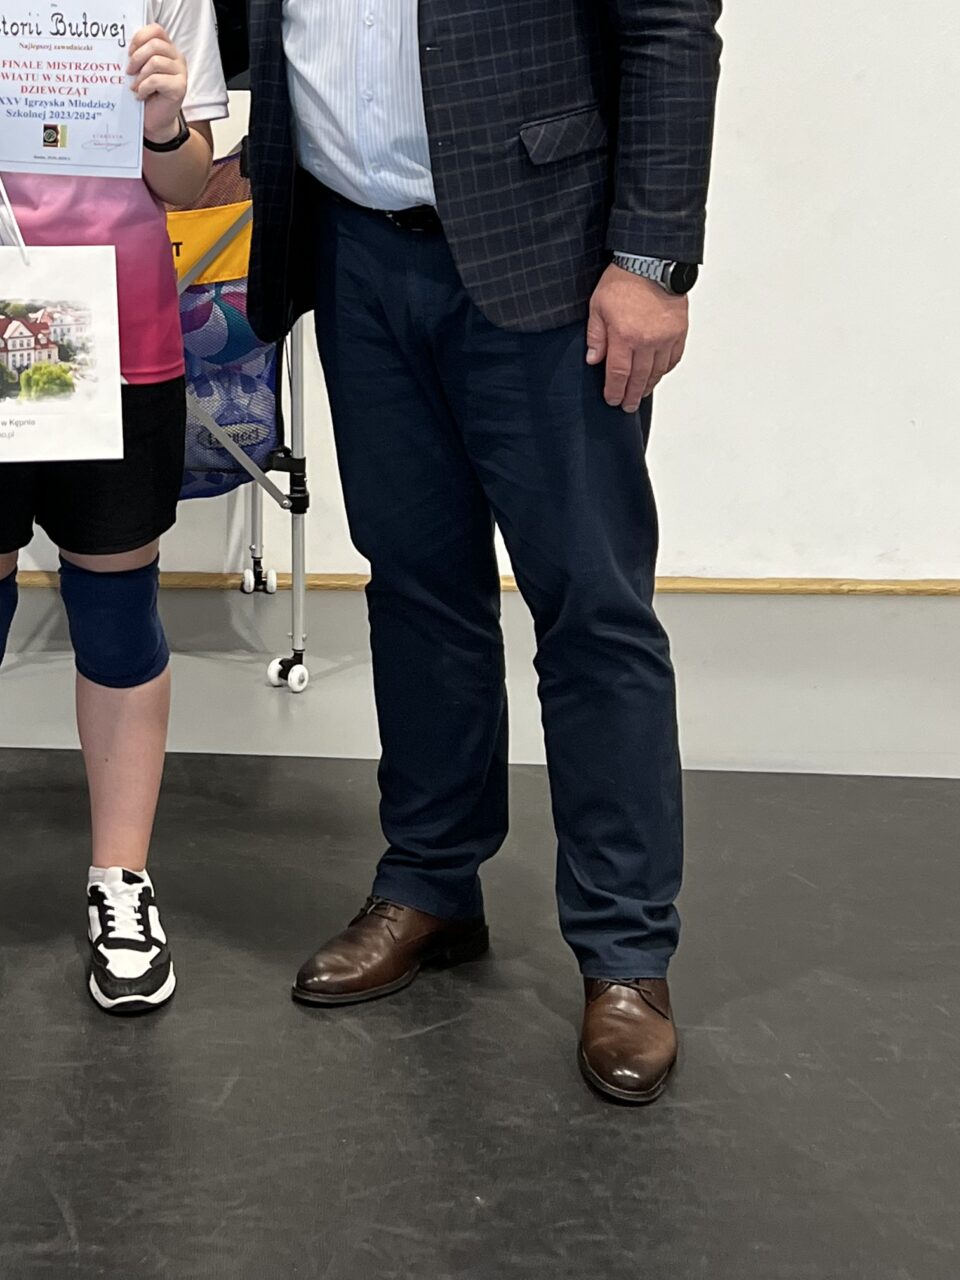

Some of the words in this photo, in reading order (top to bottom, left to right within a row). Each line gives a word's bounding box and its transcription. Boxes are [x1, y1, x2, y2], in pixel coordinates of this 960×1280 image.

[2, 59, 42, 69] FINALE
[46, 60, 122, 71] MISTRZOSTW
[42, 73, 53, 82] W
[56, 73, 125, 85] SIATKÓWCE
[20, 86, 89, 97] DZIEWCZĄT
[25, 97, 65, 108] Igrzyska
[69, 98, 116, 111] Młodzieży
[6, 108, 46, 120] Szkolnej
